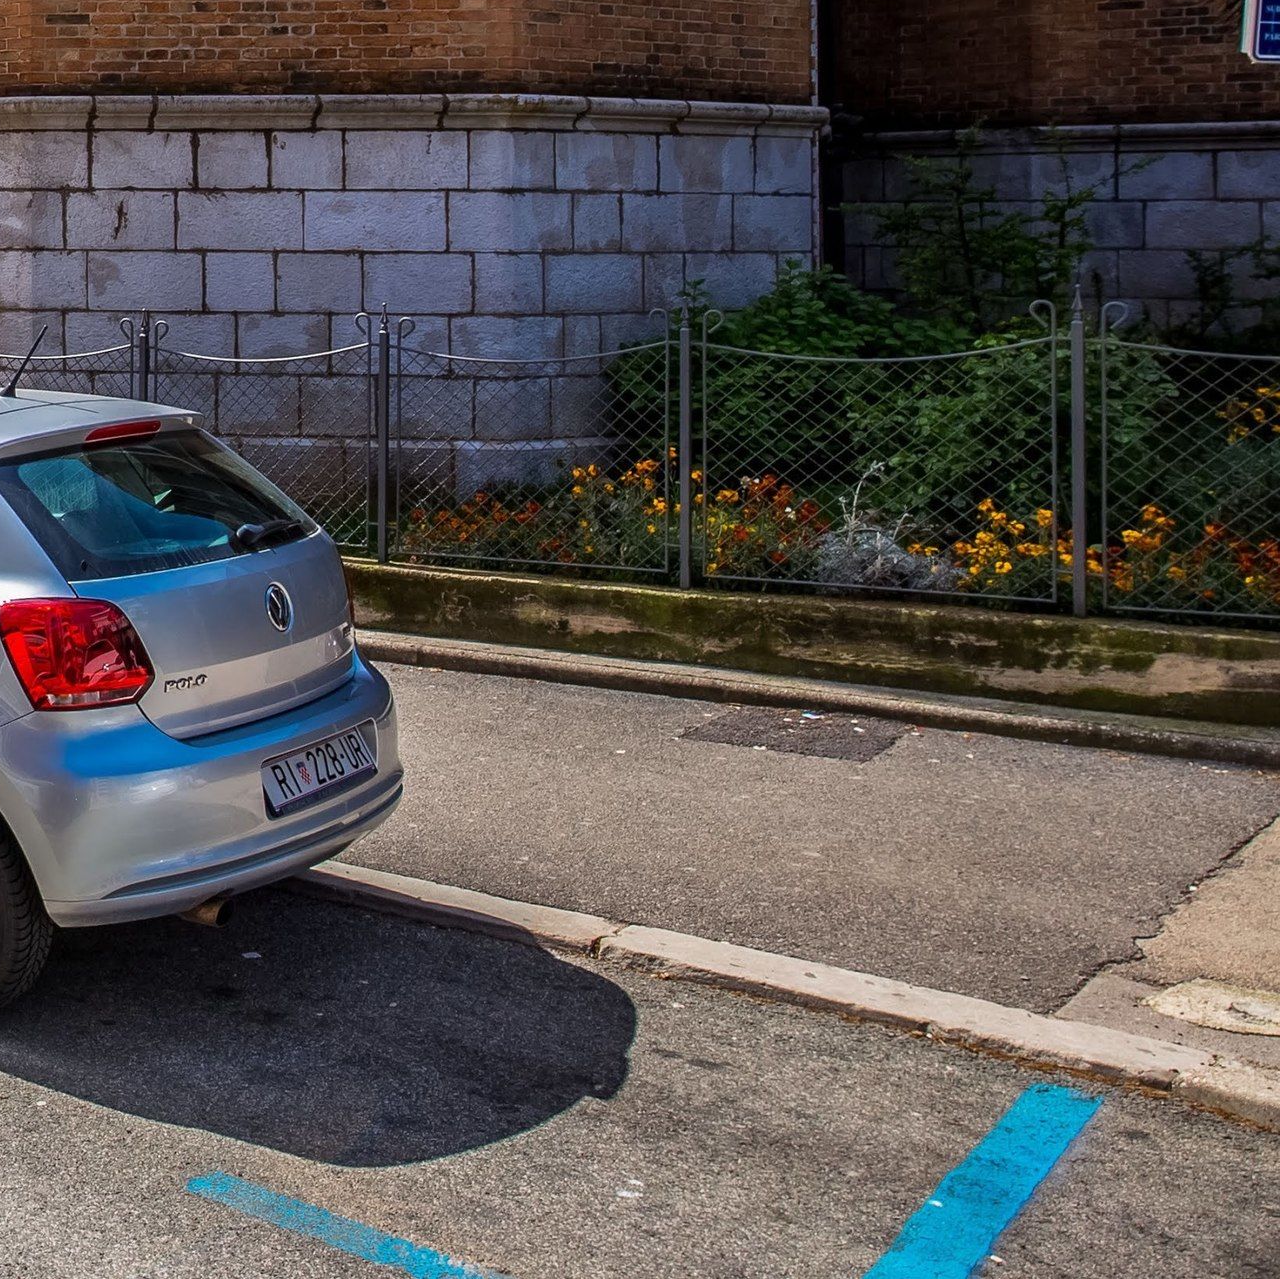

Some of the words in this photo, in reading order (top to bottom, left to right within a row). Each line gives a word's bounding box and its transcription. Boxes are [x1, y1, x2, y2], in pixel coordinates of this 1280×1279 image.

[164, 674, 208, 693] POLO
[270, 760, 303, 800] RI
[305, 733, 371, 786] 228-UR
